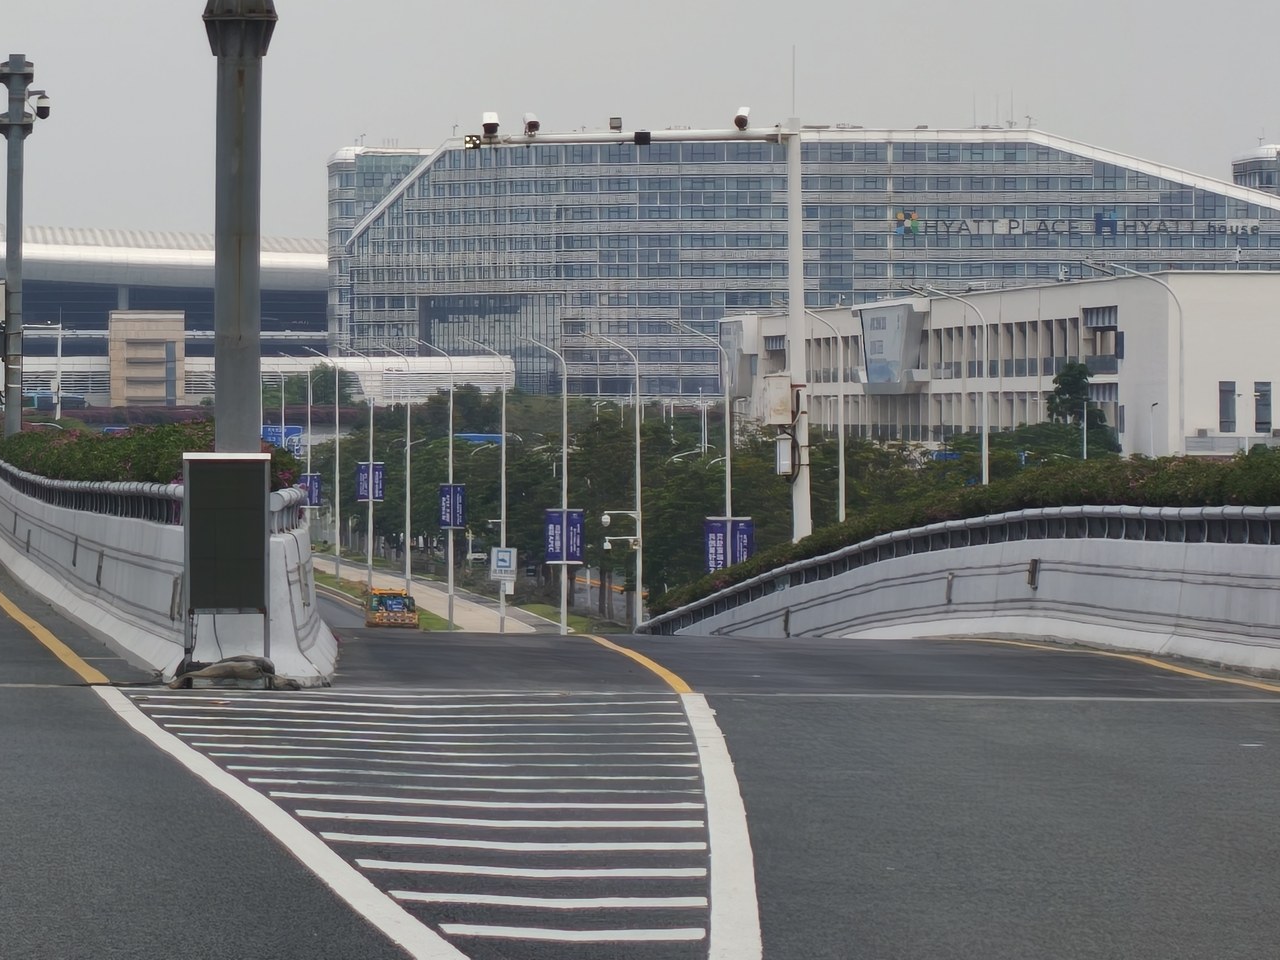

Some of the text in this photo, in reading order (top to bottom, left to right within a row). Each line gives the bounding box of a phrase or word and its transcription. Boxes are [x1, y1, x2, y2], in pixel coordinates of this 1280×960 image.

[925, 219, 1080, 235] HYATT PLACE
[1207, 221, 1260, 236] house
